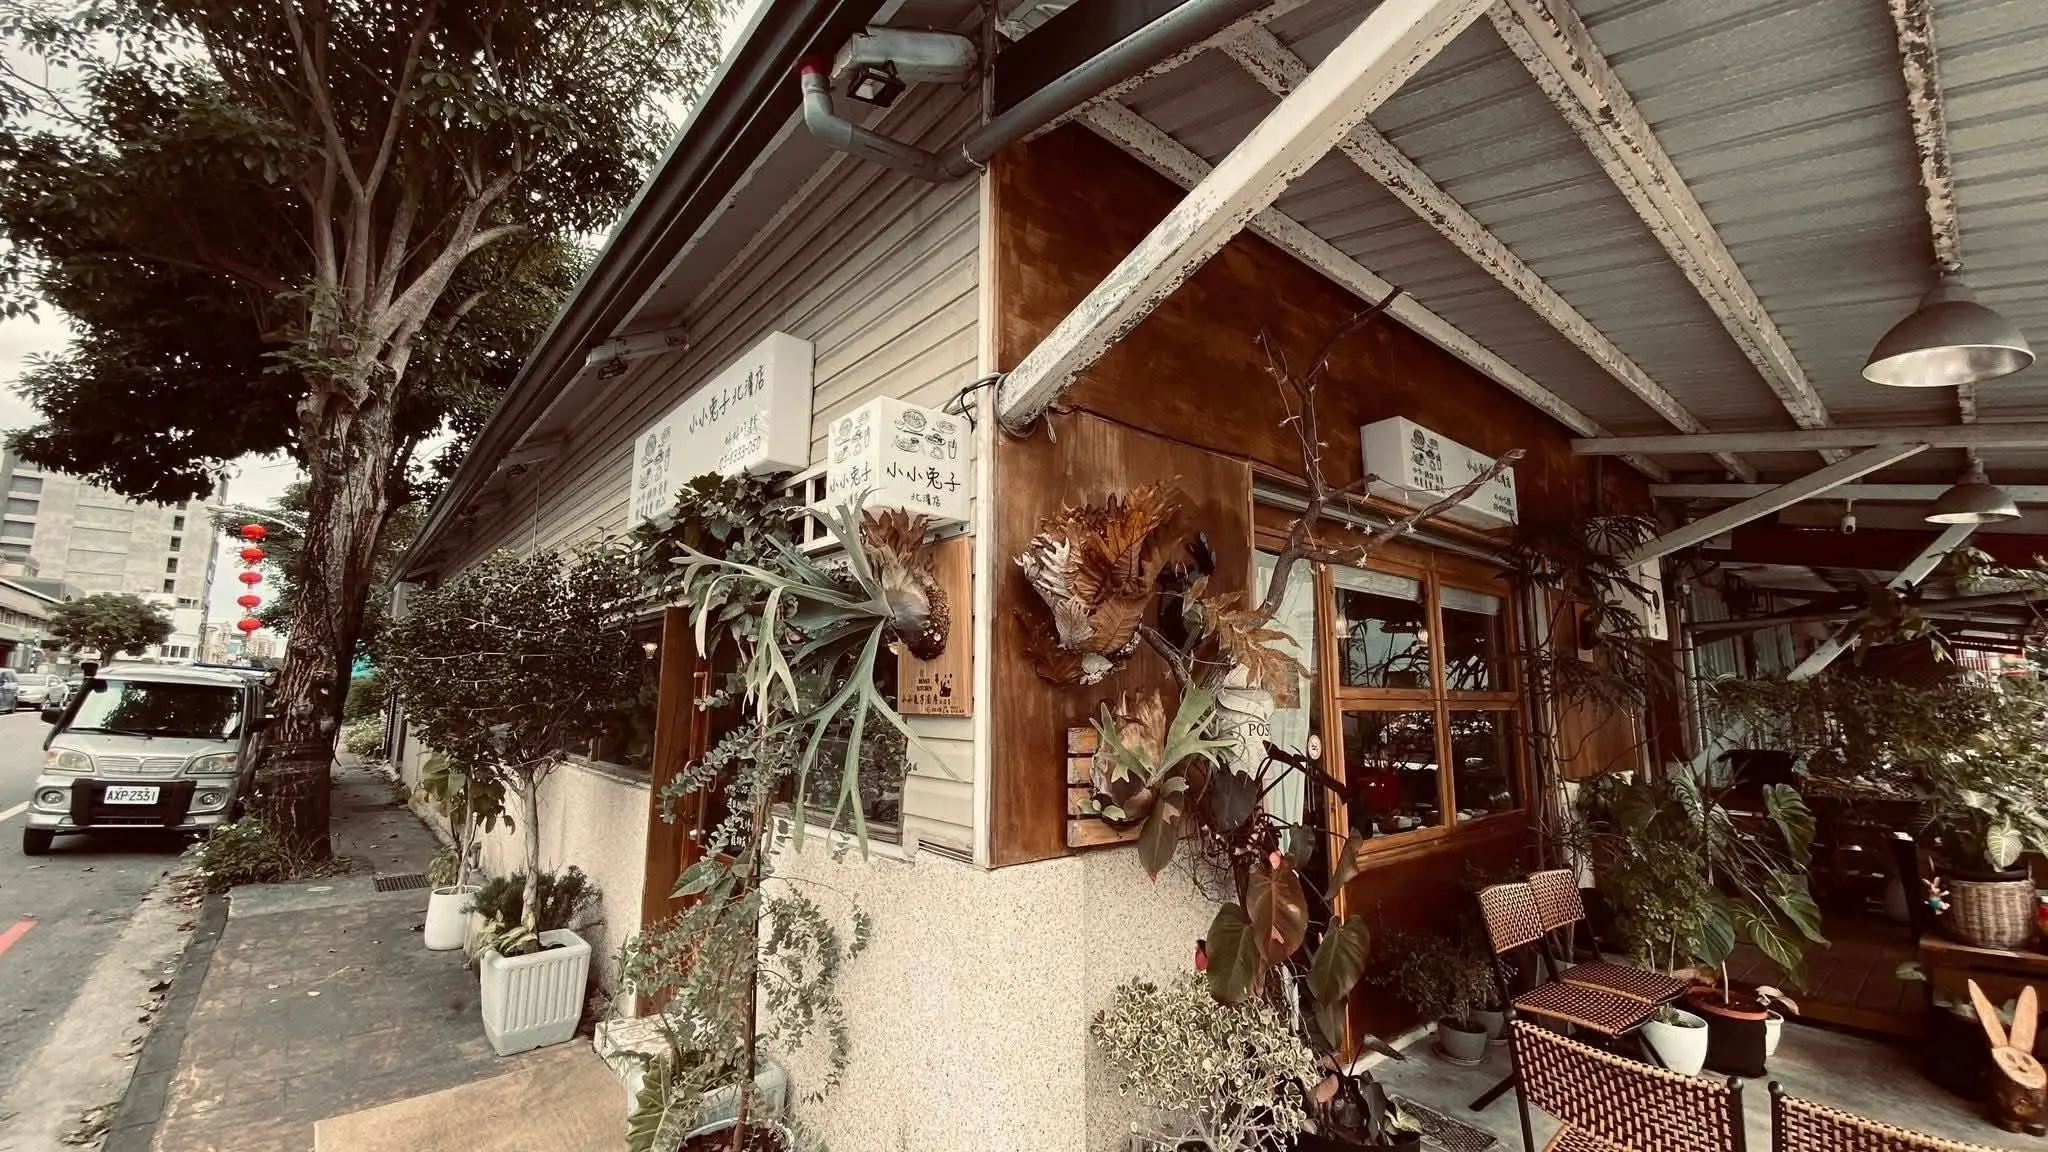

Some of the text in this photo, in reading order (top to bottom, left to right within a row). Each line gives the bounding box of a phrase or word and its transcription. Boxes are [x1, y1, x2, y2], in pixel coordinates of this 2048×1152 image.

[830, 461, 871, 493] 小小兔子
[887, 462, 960, 492] 小小兔子
[1248, 723, 1271, 737] POS
